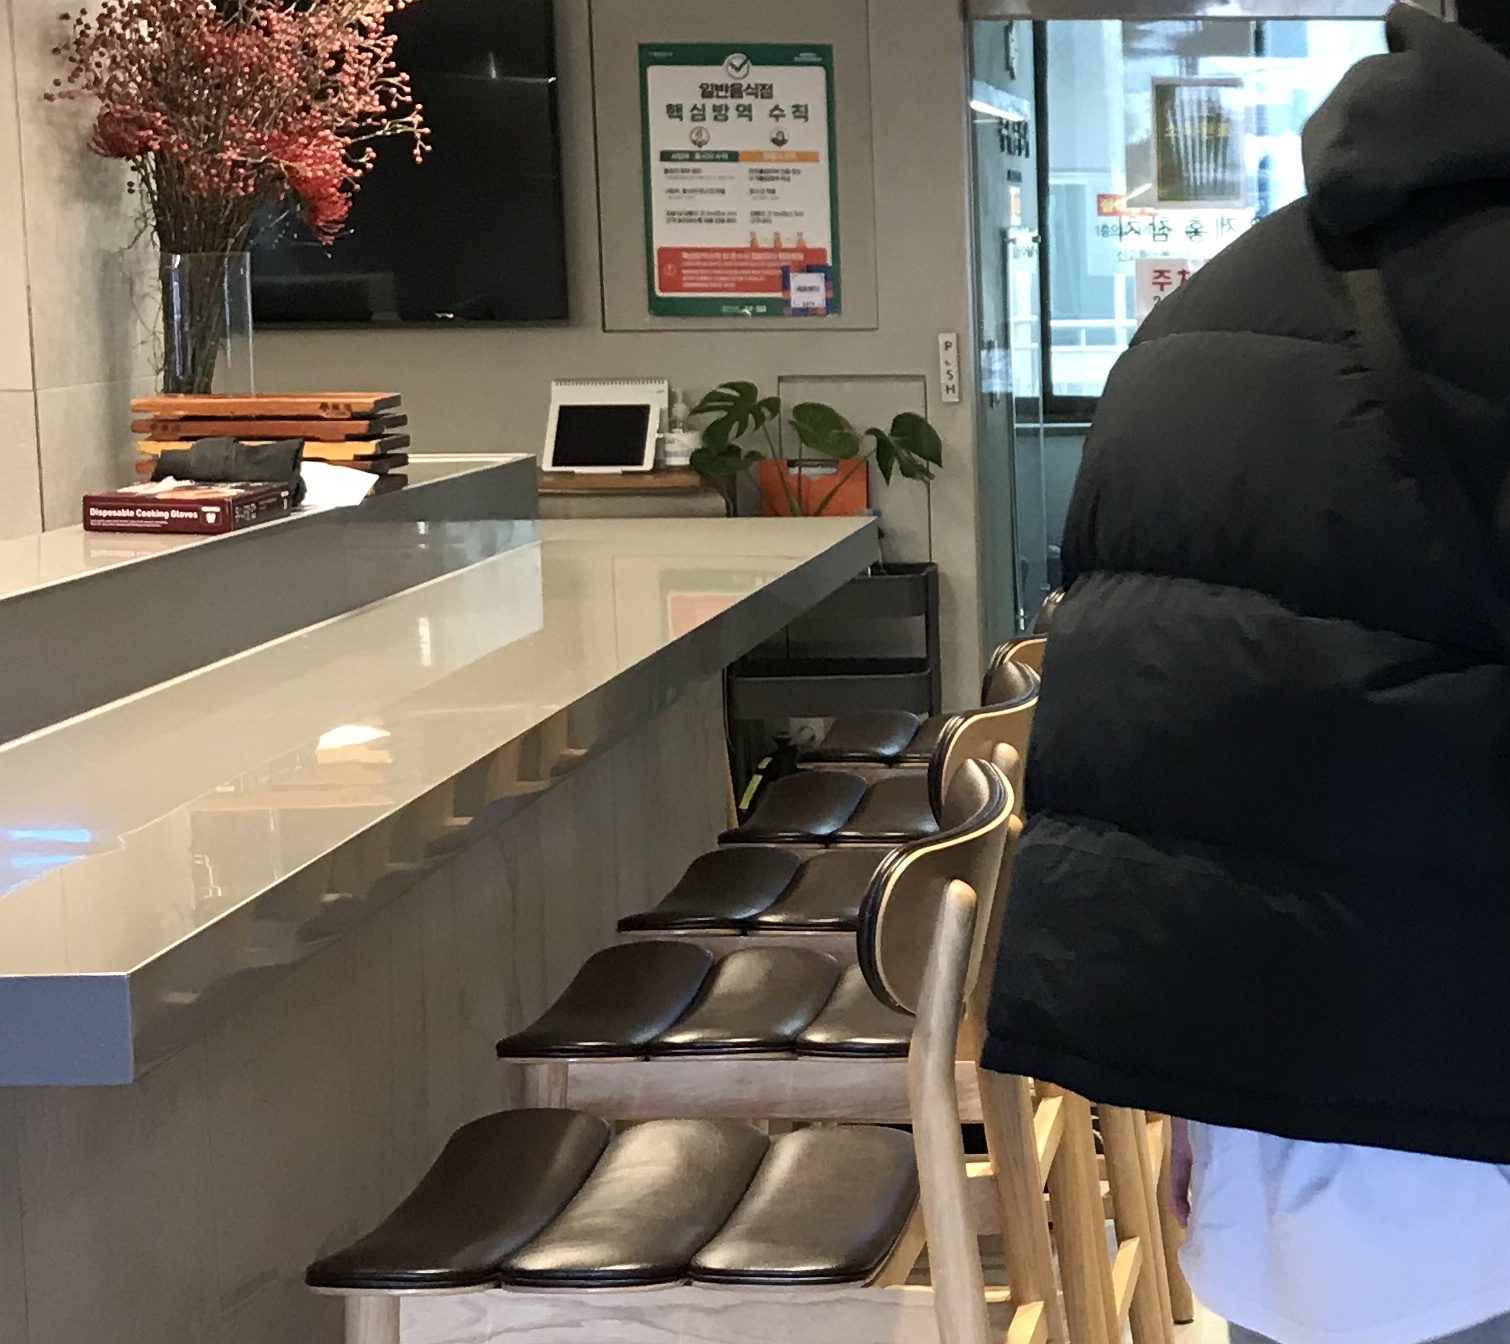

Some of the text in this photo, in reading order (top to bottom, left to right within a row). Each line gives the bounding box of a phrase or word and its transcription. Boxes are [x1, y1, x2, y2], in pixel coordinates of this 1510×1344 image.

[699, 83, 773, 99] 일반음식점
[665, 103, 809, 122] 핵심방역 수칙
[89, 507, 198, 520] Disposable Cooking Gloves
